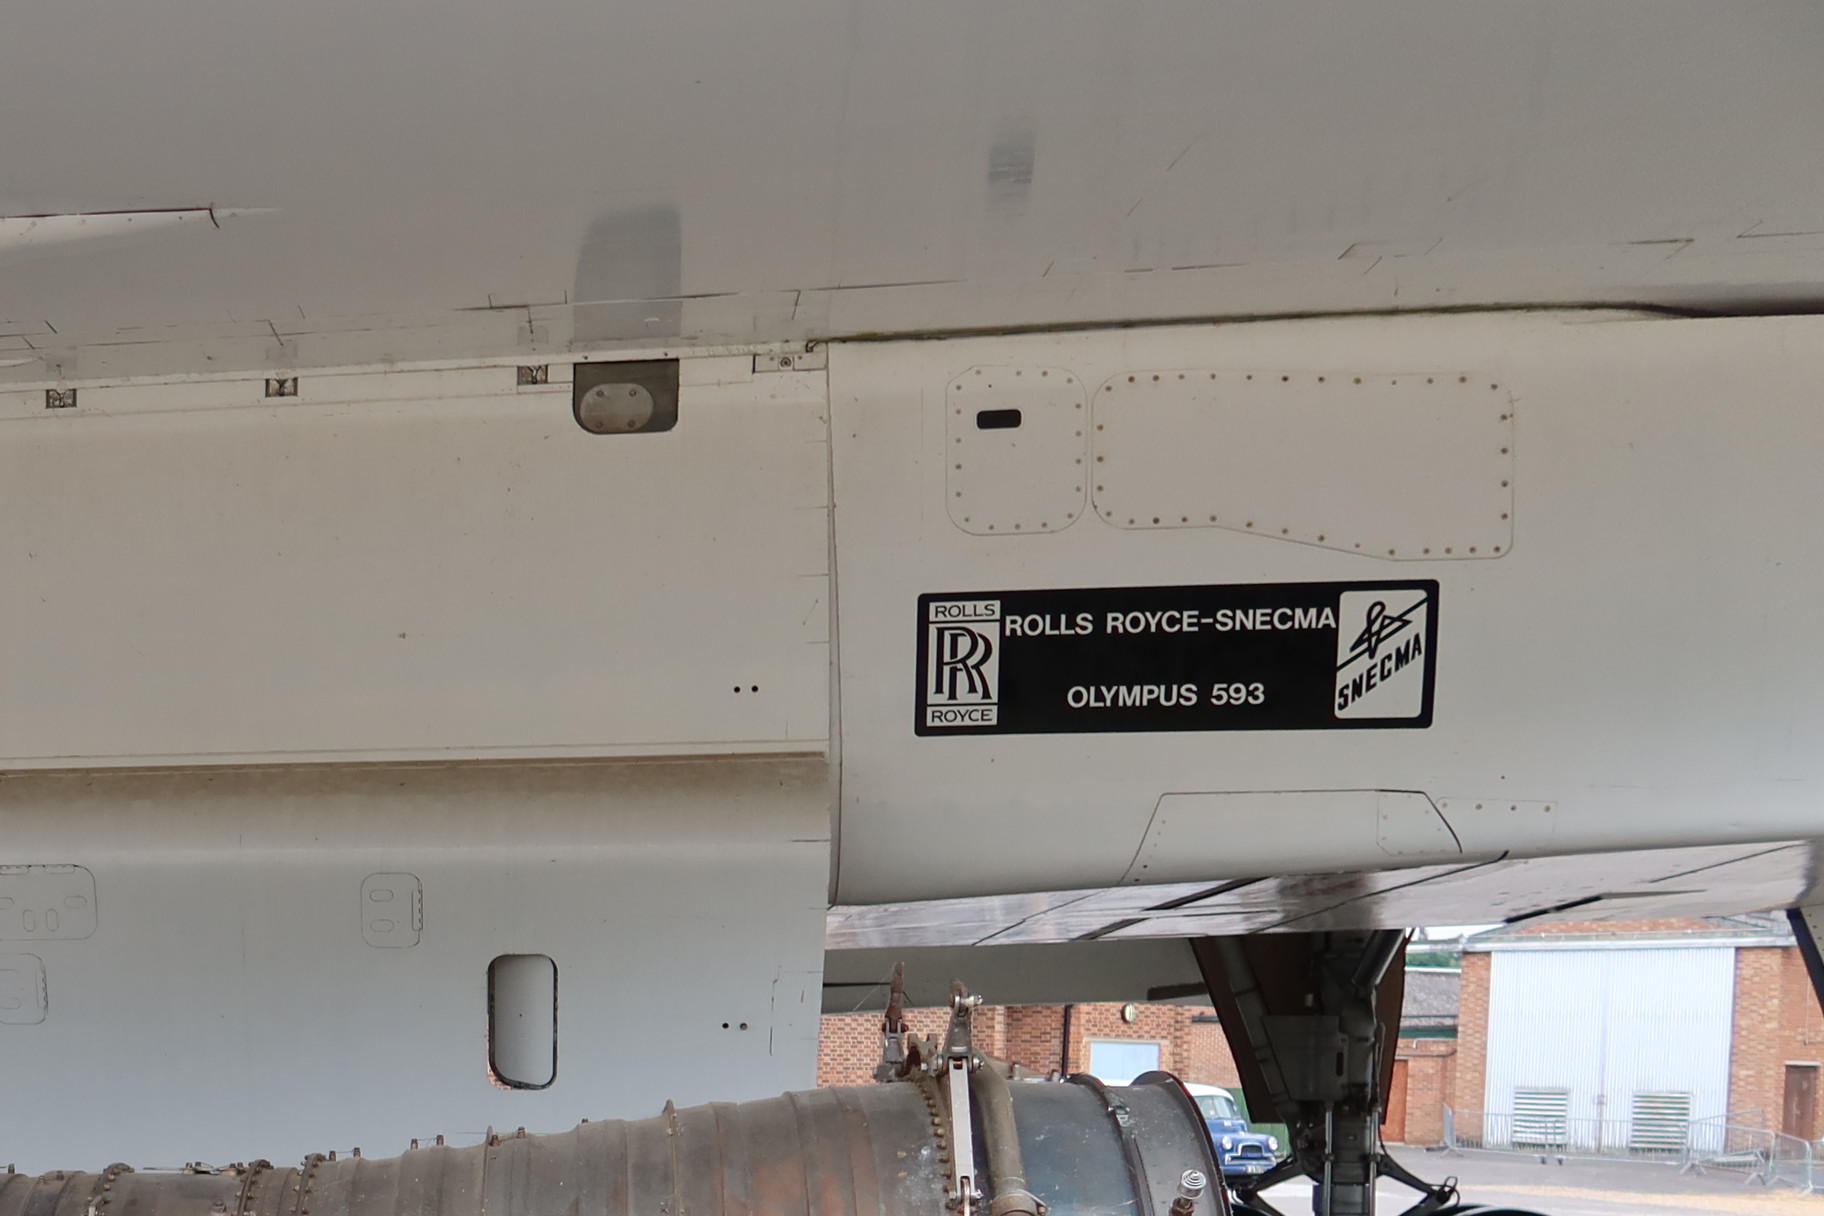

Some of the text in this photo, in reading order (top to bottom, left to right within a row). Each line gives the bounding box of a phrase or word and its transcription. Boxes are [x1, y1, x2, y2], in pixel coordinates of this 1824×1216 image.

[934, 603, 996, 619] ROLLS
[1004, 606, 1337, 637] ROLLS ROYCE-SNECMA
[1336, 633, 1424, 712] SNECMA
[1067, 682, 1266, 708] OLYMPUS 593
[930, 709, 993, 723] ROYCE
